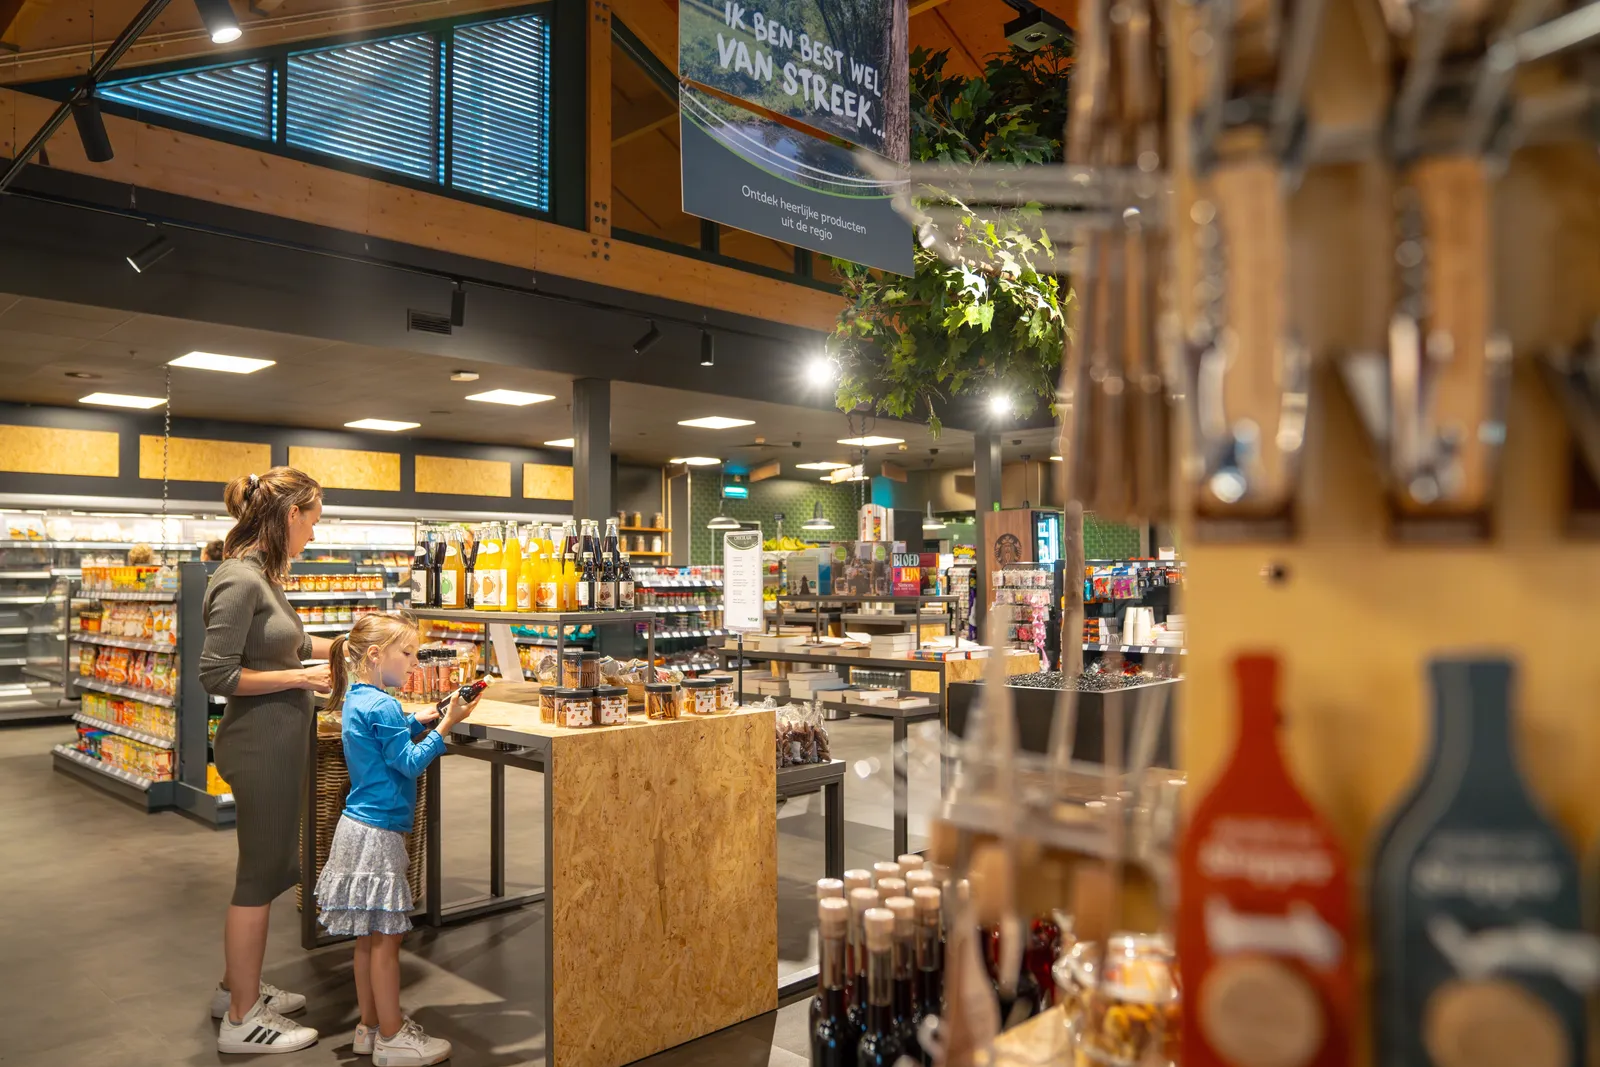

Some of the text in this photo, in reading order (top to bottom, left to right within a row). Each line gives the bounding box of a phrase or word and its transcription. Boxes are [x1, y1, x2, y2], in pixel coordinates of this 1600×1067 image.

[725, 1, 882, 98] IK BEN BEST WEL
[717, 33, 886, 139] VAN STREEK...
[741, 184, 867, 235] Ontdek heerlijke producten
[781, 215, 833, 241] uit de regio
[893, 553, 920, 567] BLOED
